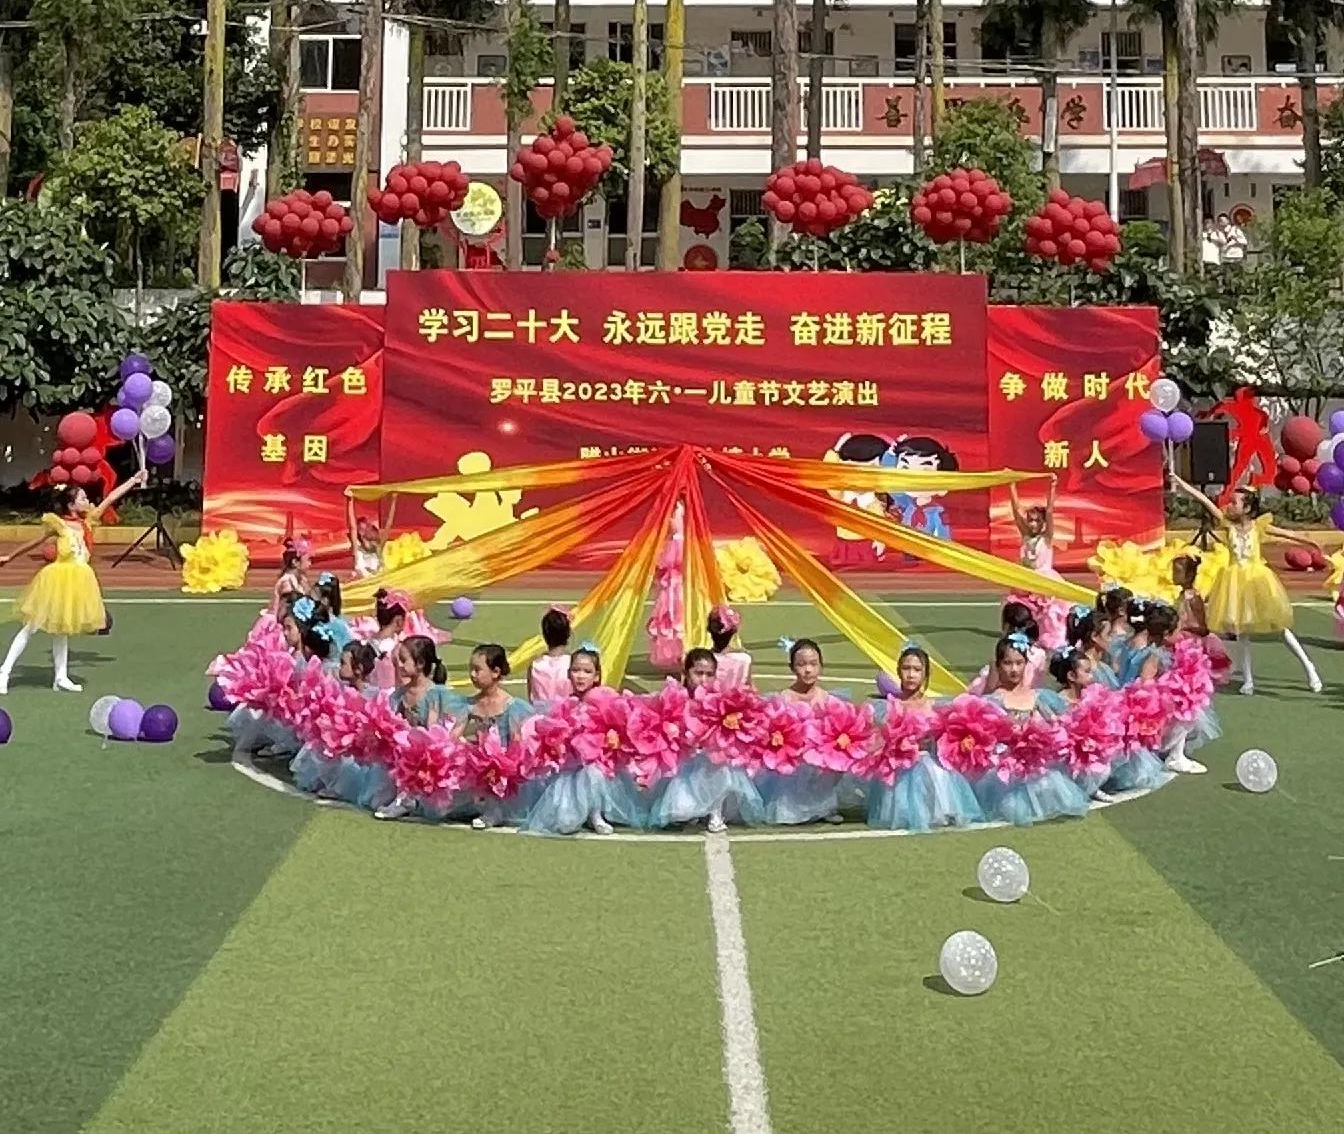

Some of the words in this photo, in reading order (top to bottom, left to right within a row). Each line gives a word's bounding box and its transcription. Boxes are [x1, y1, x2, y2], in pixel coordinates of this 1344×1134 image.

[418, 308, 580, 344] 学习二十大
[602, 310, 766, 346] 永远跟党走
[790, 310, 952, 346] 奋进新征程
[226, 365, 367, 395] 传承红色
[999, 371, 1152, 401] 争做时代
[260, 433, 328, 463] 基因
[1044, 440, 1109, 468] 新人
